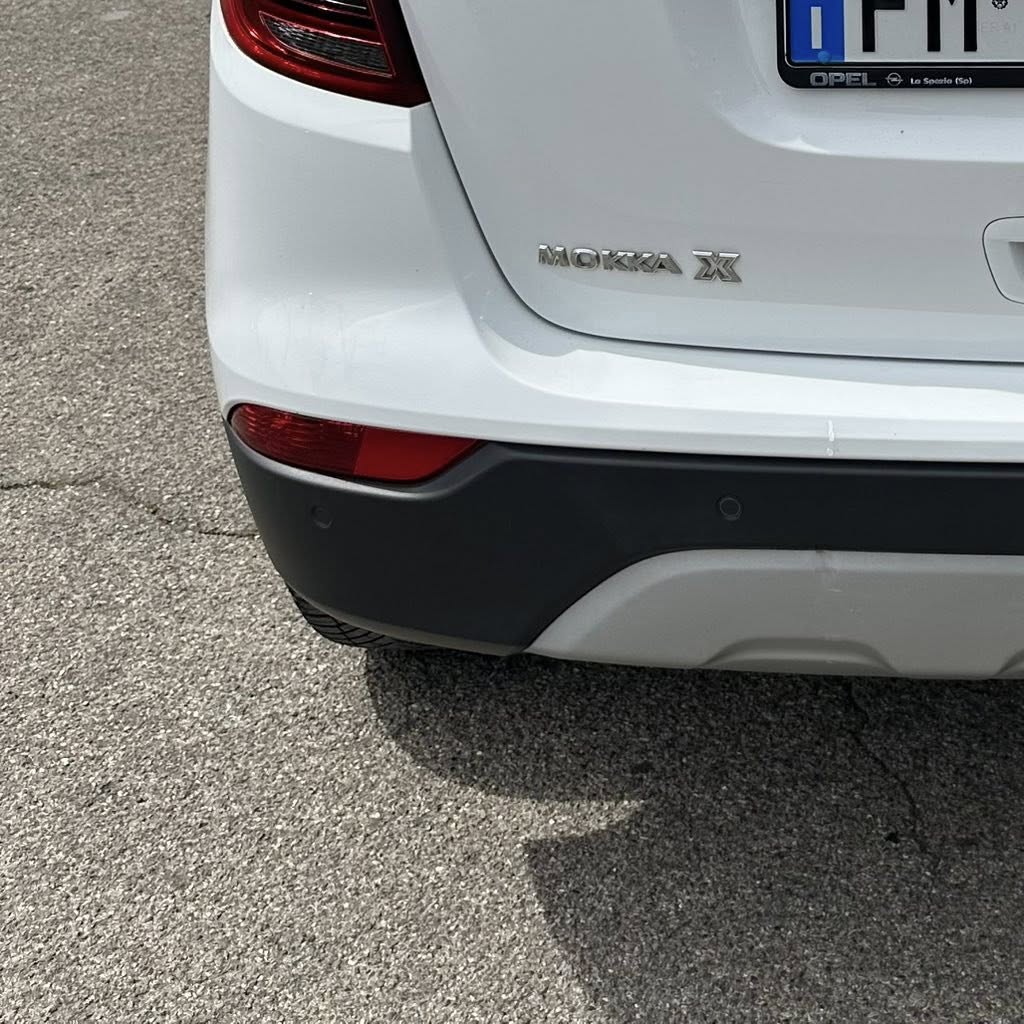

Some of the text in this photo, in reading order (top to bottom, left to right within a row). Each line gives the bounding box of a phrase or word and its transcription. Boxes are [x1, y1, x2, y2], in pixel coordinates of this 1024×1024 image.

[810, 6, 823, 50] I
[809, 72, 877, 87] OPEL
[538, 244, 743, 283] MOKKA X
